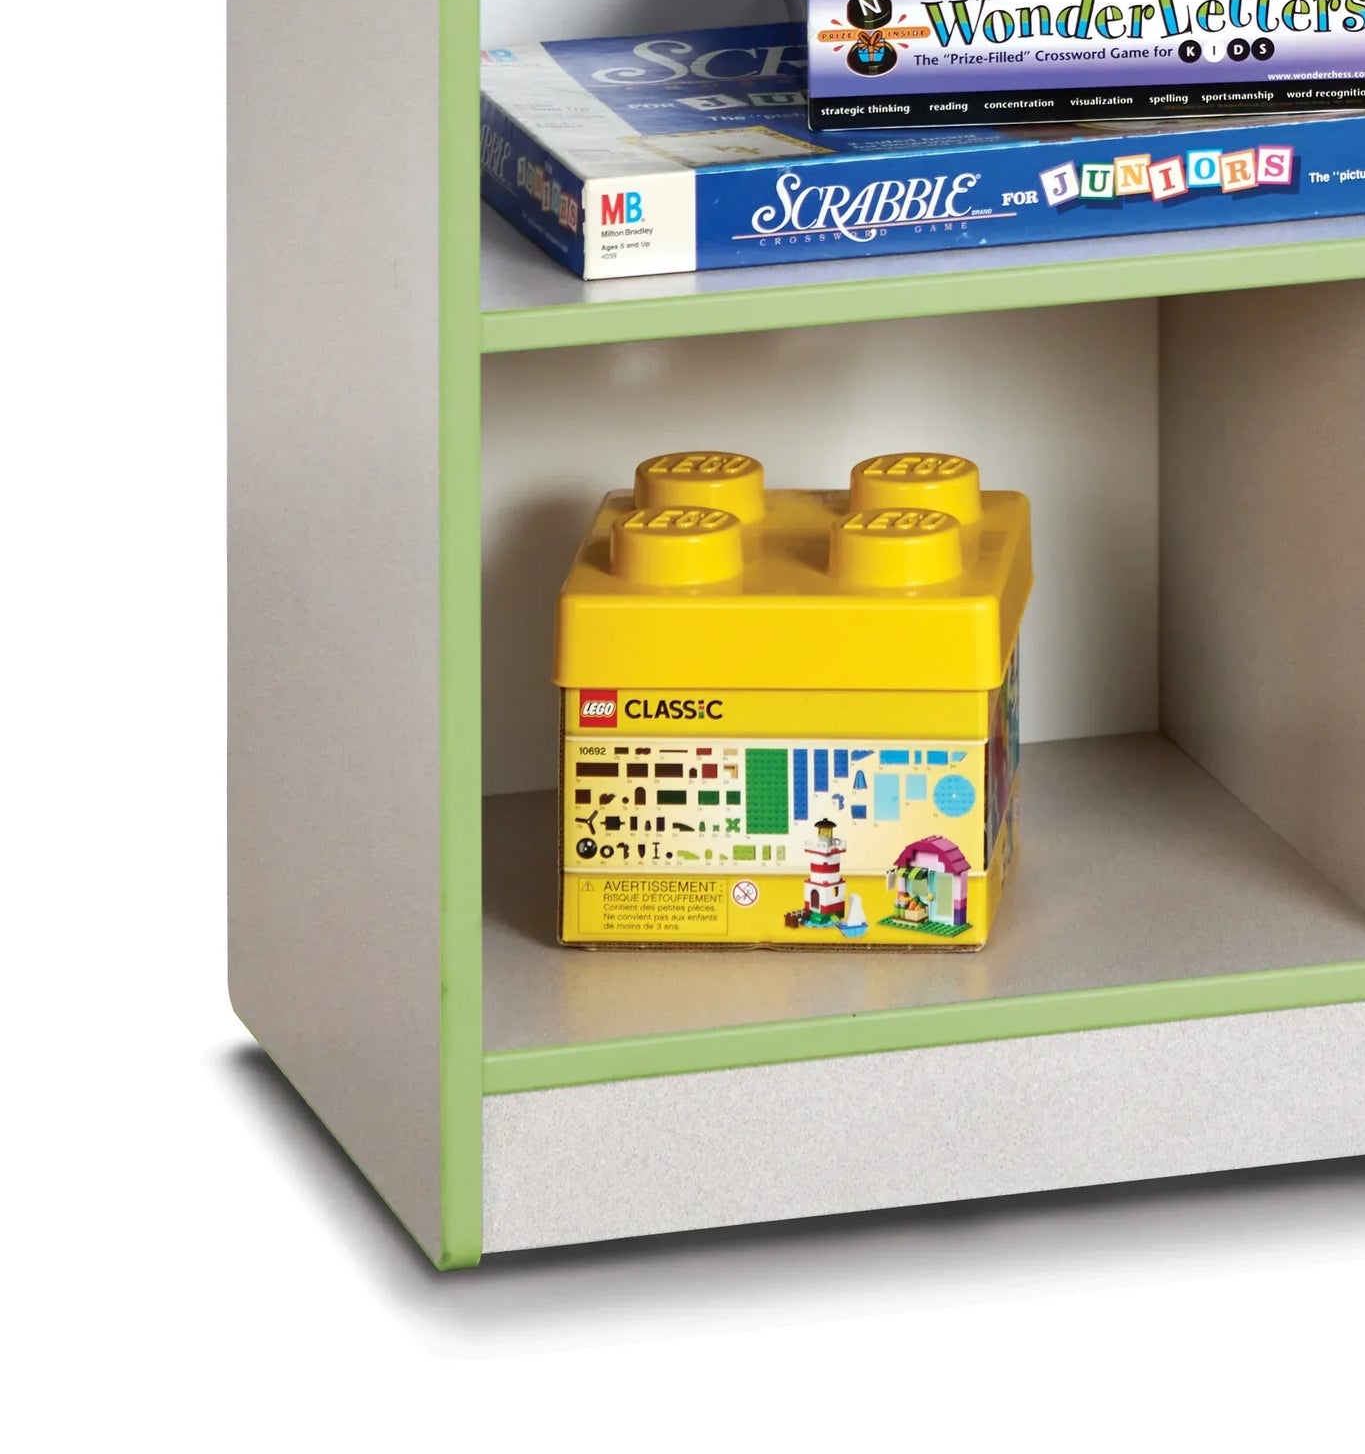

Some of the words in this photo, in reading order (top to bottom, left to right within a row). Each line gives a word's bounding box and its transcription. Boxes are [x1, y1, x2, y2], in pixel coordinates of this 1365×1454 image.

[821, 32, 853, 40] PRIZE
[887, 29, 926, 38] INSIDE
[914, 54, 939, 66] The
[1035, 48, 1106, 61] Crossword
[1110, 47, 1150, 59] Game
[1153, 46, 1174, 58] for
[1070, 95, 1133, 106] visualization
[1149, 93, 1189, 106] spelling
[1201, 90, 1275, 103] sportsmanship
[1286, 90, 1314, 99] word
[821, 105, 866, 116] strategic
[867, 103, 910, 115] thinking
[929, 101, 969, 113] reading
[984, 98, 1054, 109] concentration
[1001, 191, 1038, 206] FOR
[1050, 152, 1287, 199] JUNIORS
[1309, 172, 1330, 183] The
[751, 172, 978, 243] SCRABBLE
[601, 229, 624, 238] Milton
[625, 227, 654, 236] Bradley
[759, 228, 888, 246] CROSSWORD
[914, 222, 968, 234] GAME
[648, 456, 752, 474] LEGO
[862, 456, 966, 475] LEGO
[624, 510, 729, 529] LEGO
[842, 511, 947, 530] LEGO
[581, 700, 616, 718] LEGO
[579, 747, 606, 756] 10692
[604, 881, 716, 893] AVERTISSEMENT
[604, 894, 639, 904] RISQUE
[604, 903, 638, 912] Contient
[657, 903, 685, 914] petites
[604, 913, 615, 922] Ne
[617, 913, 652, 922] convient
[654, 914, 669, 923] pas
[687, 913, 718, 922] enfants
[604, 922, 614, 930] de
[617, 922, 642, 930] moins
[644, 922, 655, 930] de
